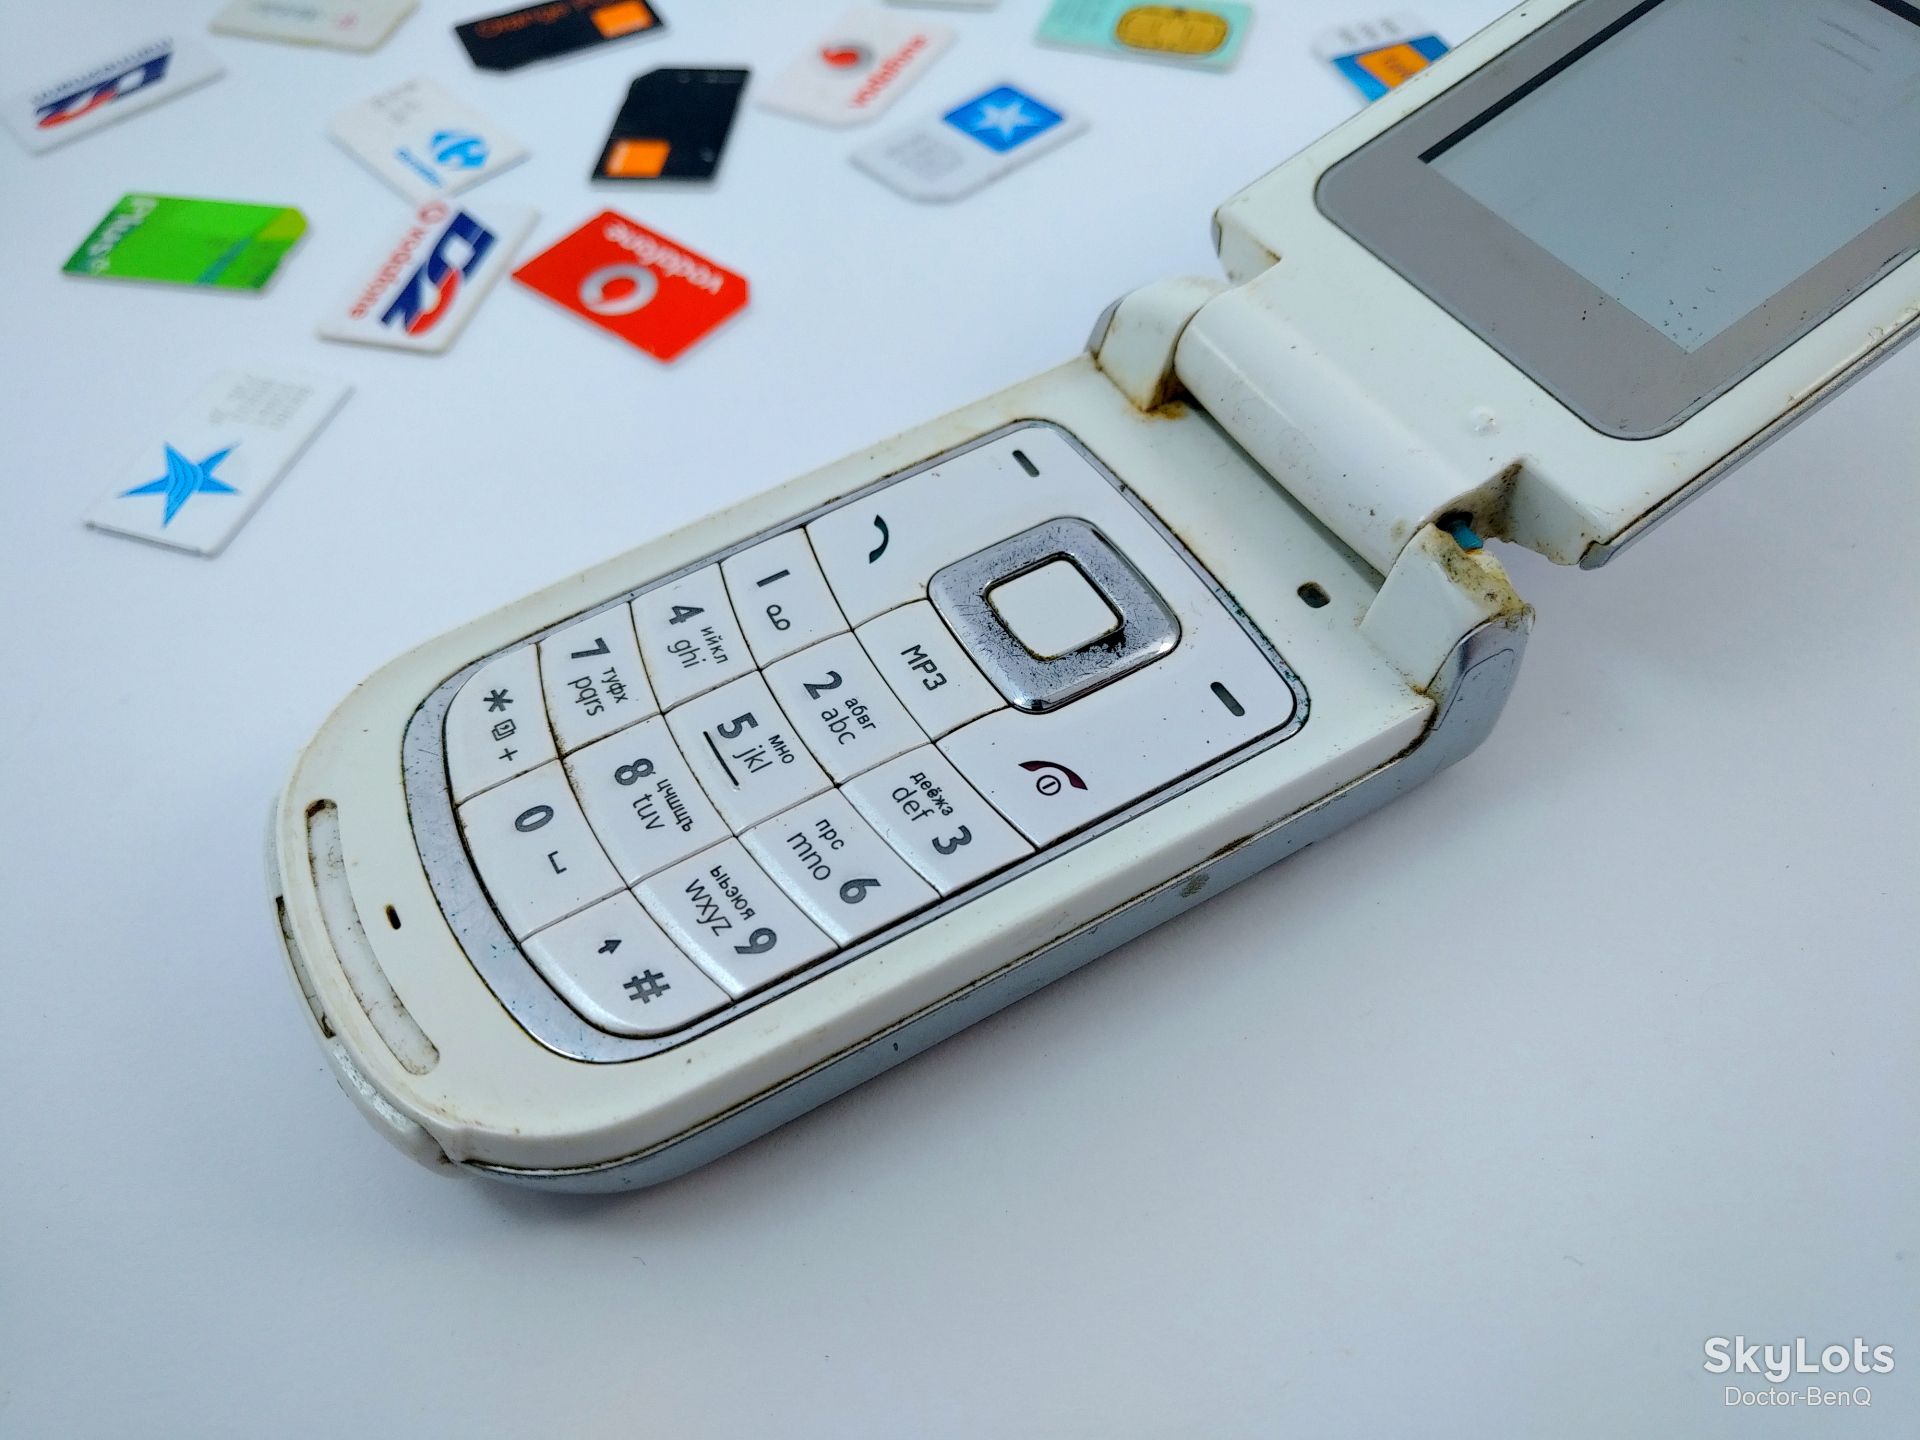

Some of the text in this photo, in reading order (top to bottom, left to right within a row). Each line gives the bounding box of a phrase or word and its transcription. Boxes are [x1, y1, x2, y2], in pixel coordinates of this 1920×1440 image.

[602, 221, 725, 296] vodafone
[669, 604, 705, 625] 4
[571, 637, 611, 660] 7
[667, 639, 707, 669] ghi
[700, 626, 729, 665] ийкл
[900, 644, 948, 692] MP3
[567, 676, 605, 717] pqrs
[601, 666, 629, 705] туфх
[803, 670, 843, 700] 2
[717, 712, 759, 739] 5
[821, 708, 856, 745] abc
[844, 698, 877, 730] абвг
[732, 744, 774, 774] jkl
[767, 734, 795, 764] мно
[614, 757, 655, 786] 8
[891, 786, 935, 822] def
[910, 772, 954, 816] деёжз
[514, 804, 554, 833] 0
[632, 793, 665, 830] tuv
[815, 818, 845, 850] прс
[932, 825, 972, 855] 3
[786, 832, 831, 880] mno
[839, 878, 882, 904] 6
[684, 878, 733, 937] wxyz
[734, 927, 777, 955] 9
